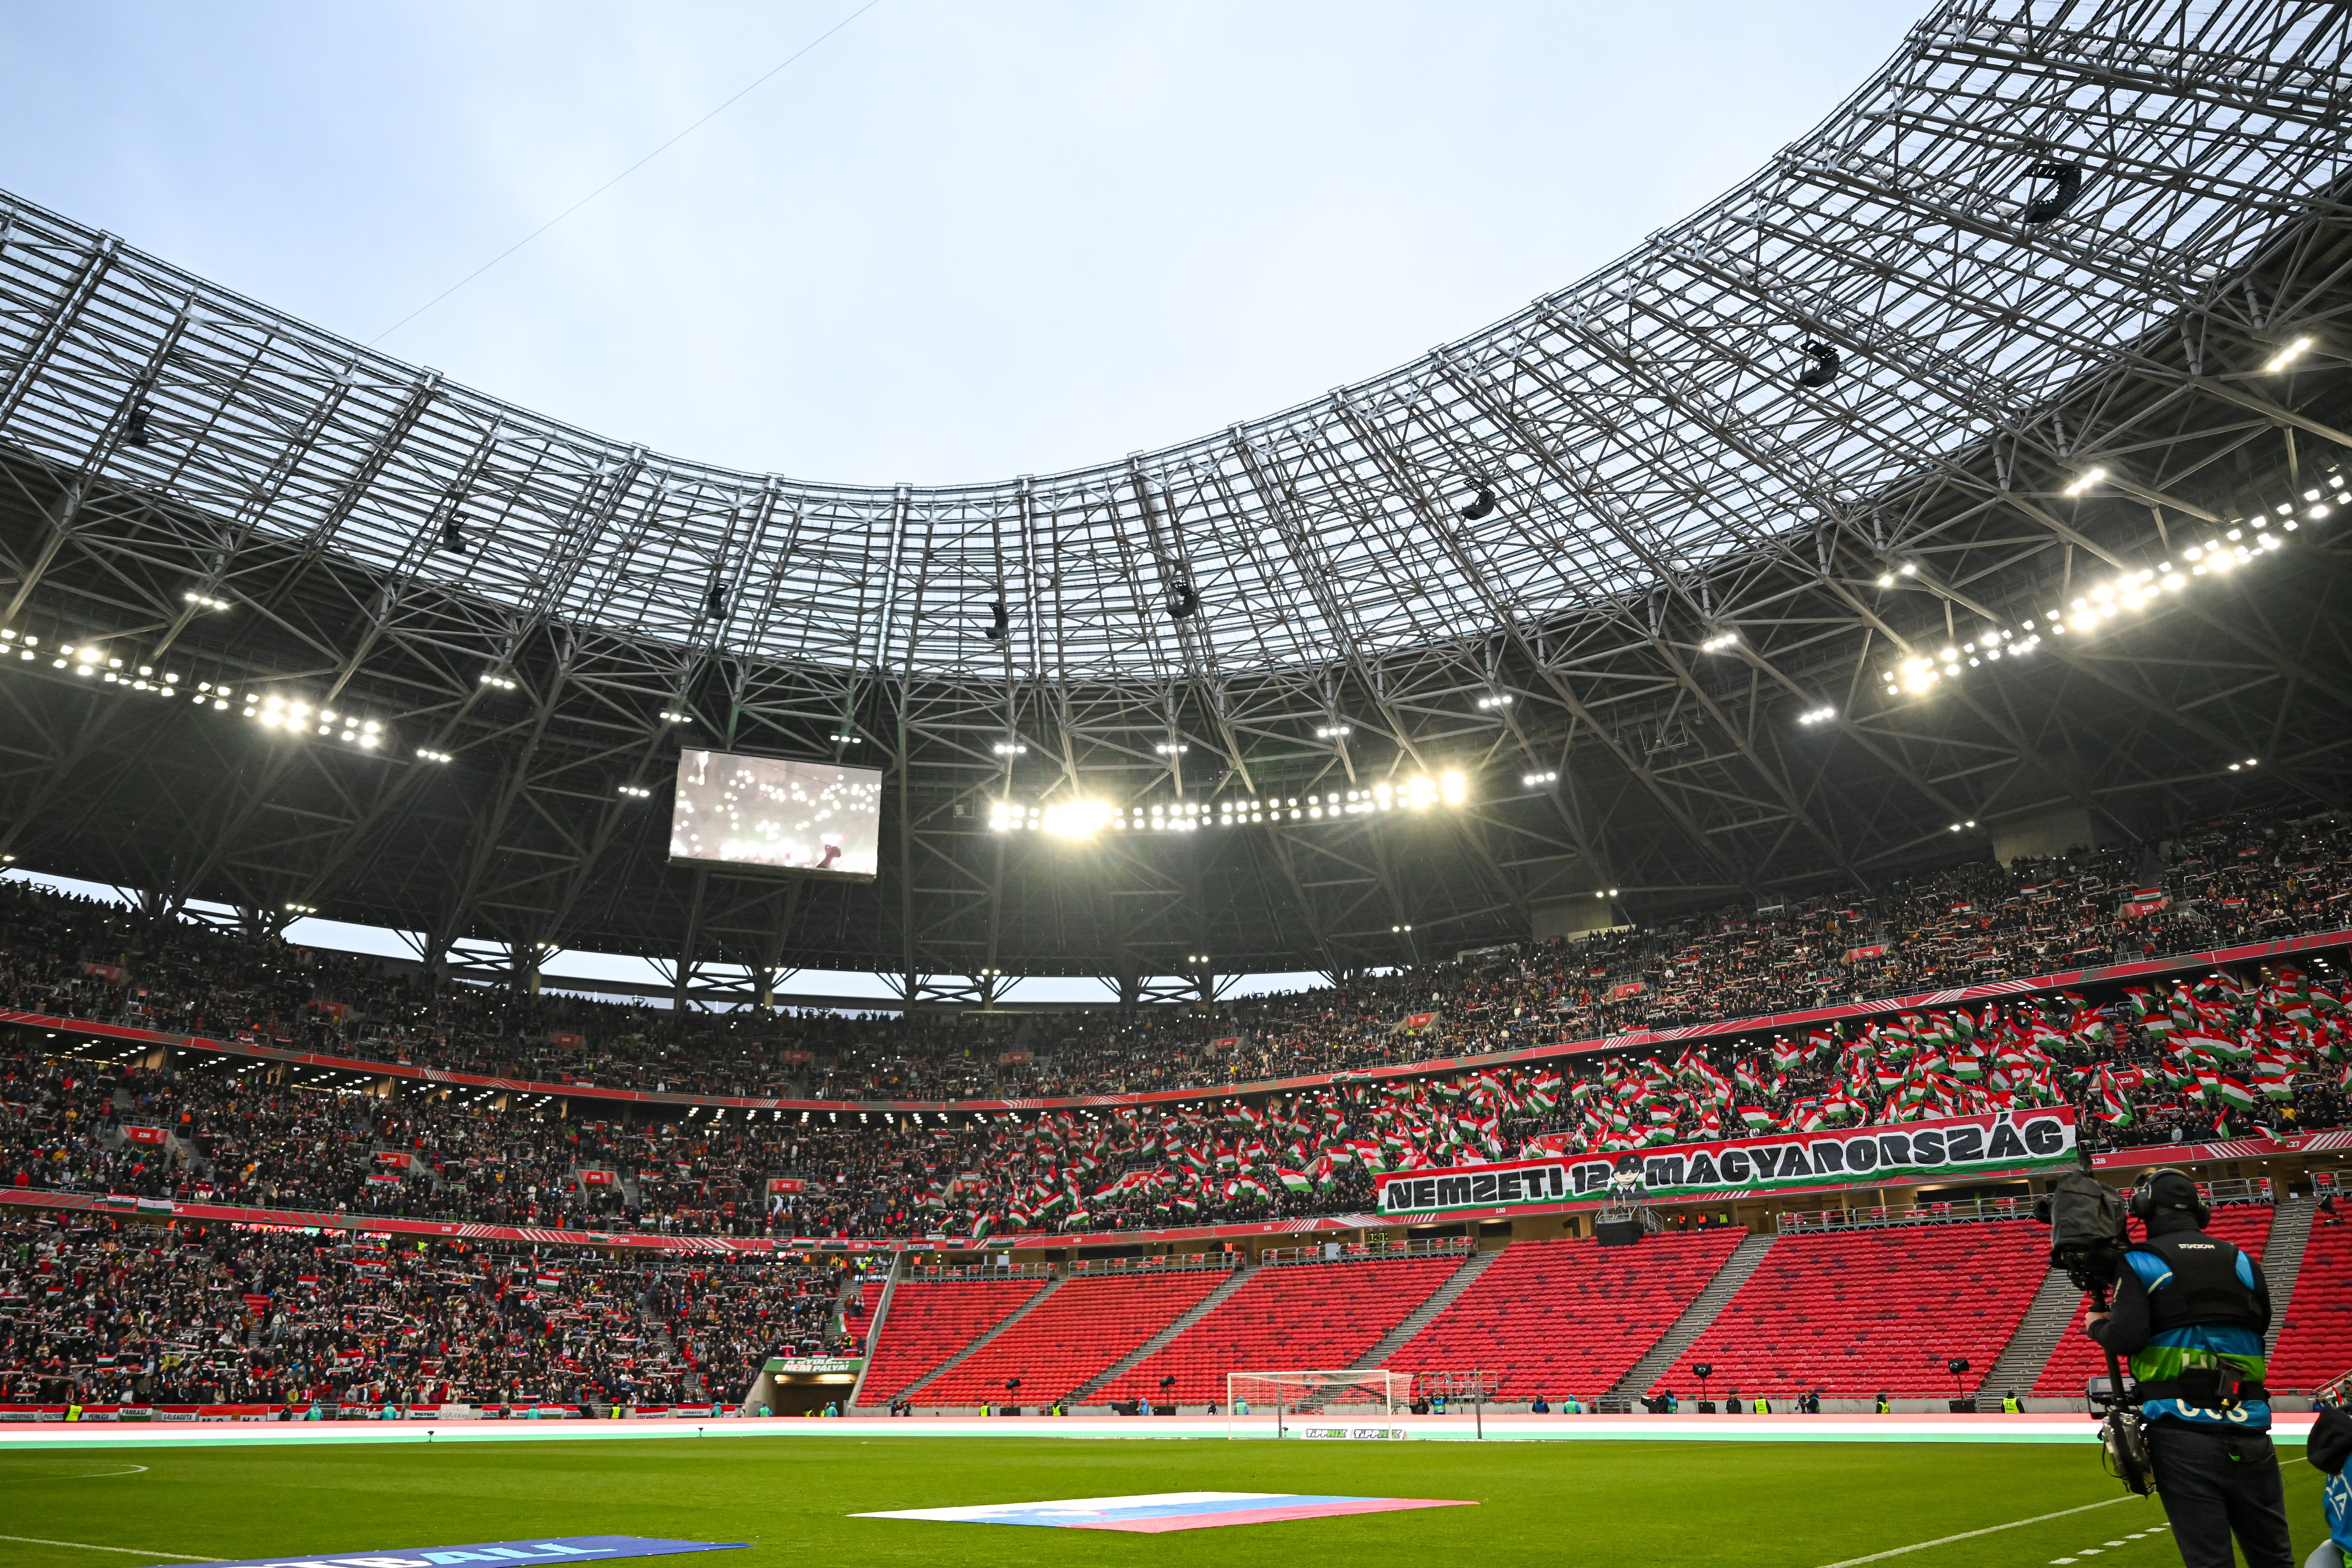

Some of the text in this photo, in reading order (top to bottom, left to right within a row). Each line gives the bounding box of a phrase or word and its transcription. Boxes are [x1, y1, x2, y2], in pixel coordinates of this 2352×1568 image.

[1387, 1112, 2064, 1209] NEMZETI 12 MAGYARORSZÁG
